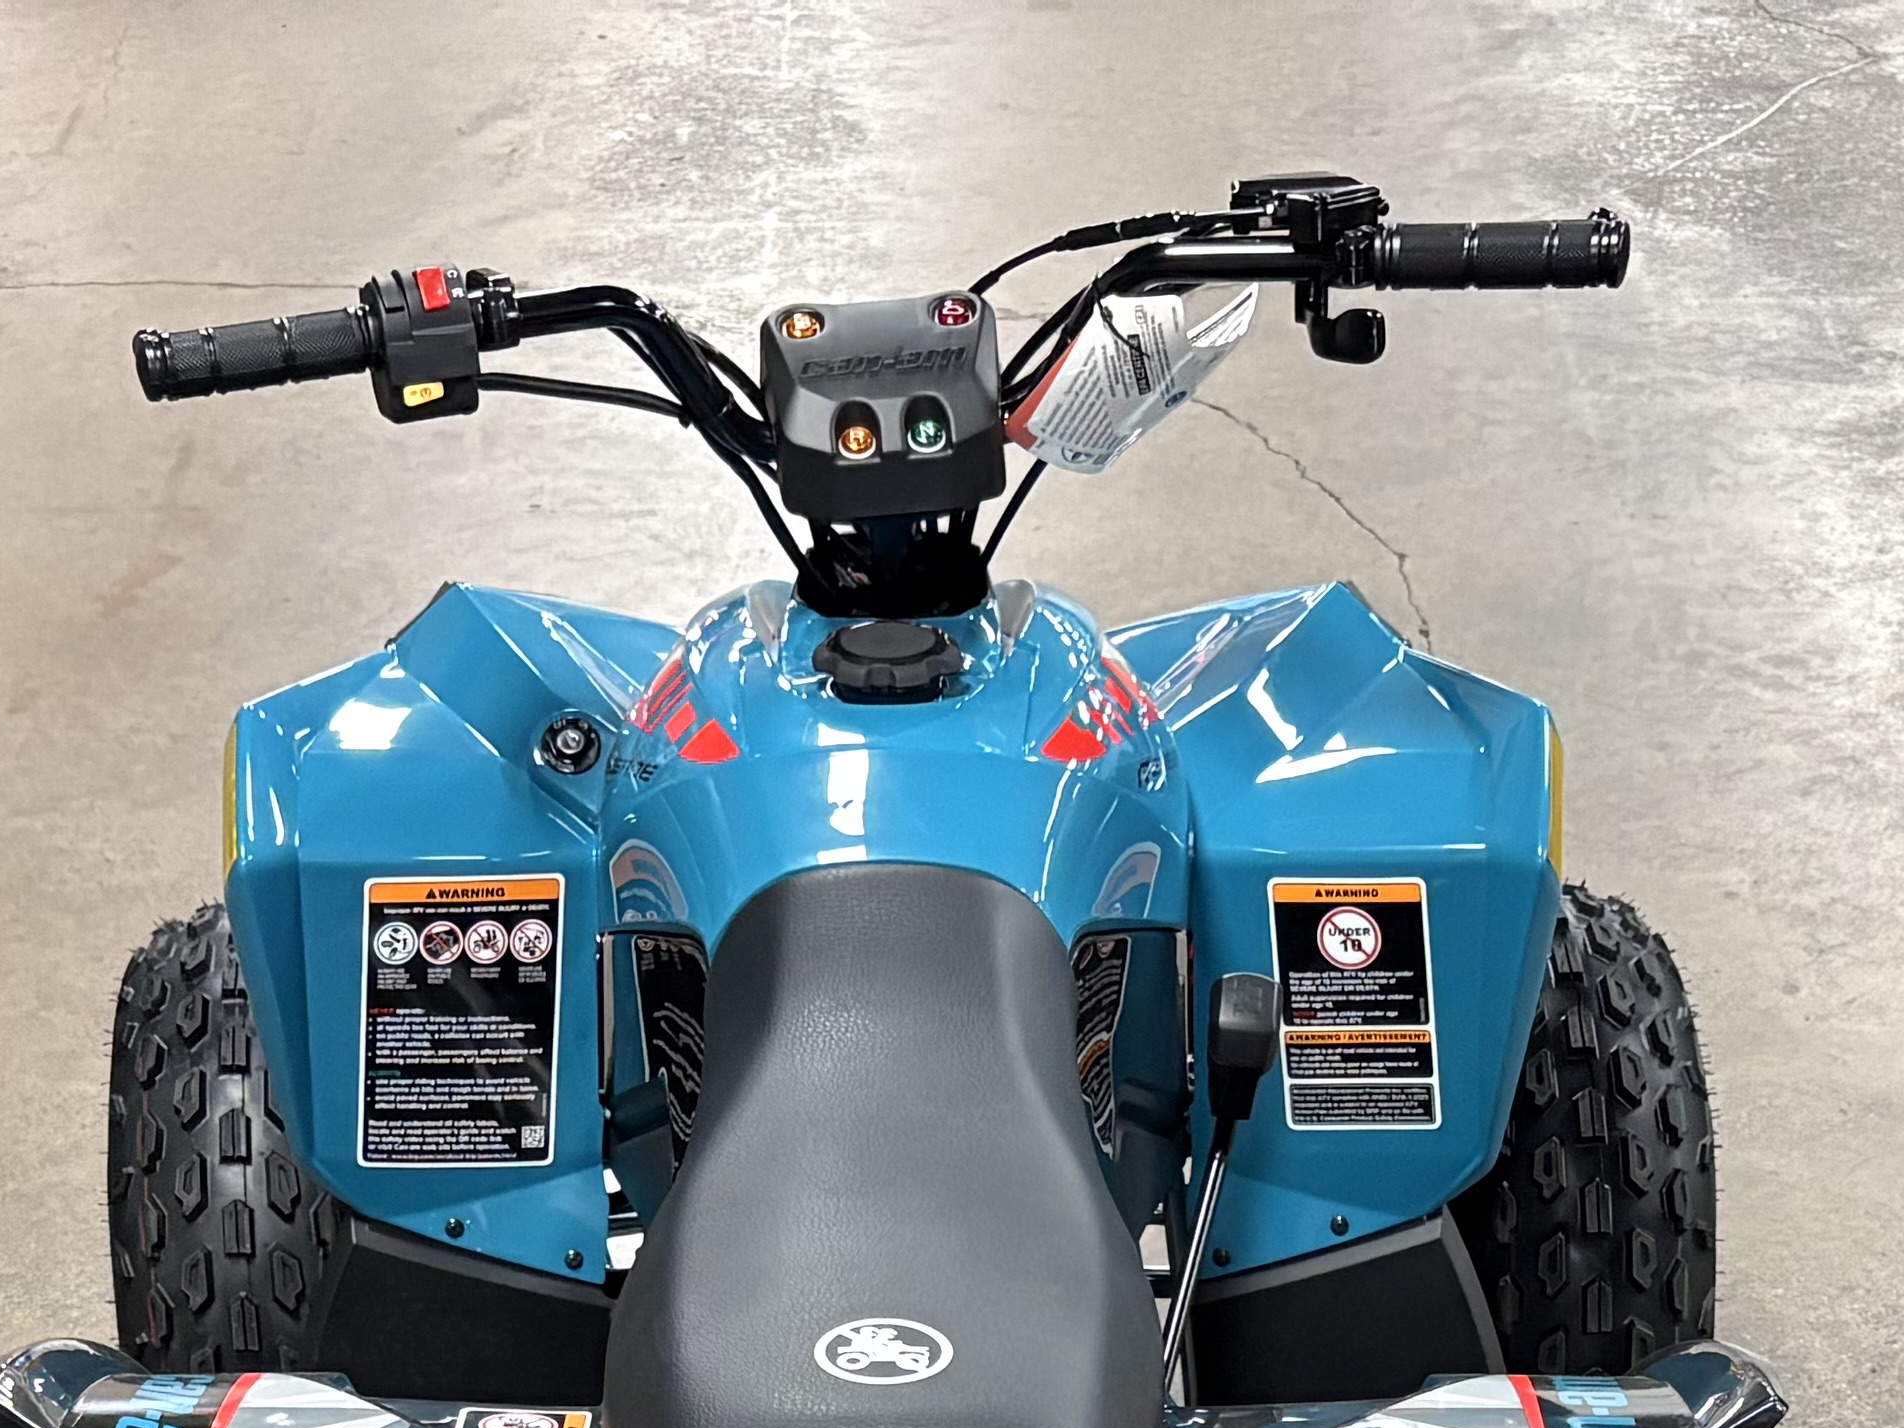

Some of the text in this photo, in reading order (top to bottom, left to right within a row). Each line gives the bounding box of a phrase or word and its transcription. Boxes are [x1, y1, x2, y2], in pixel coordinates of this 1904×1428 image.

[916, 420, 935, 444] N
[438, 887, 506, 900] WARNING
[1324, 888, 1379, 898] WARNING
